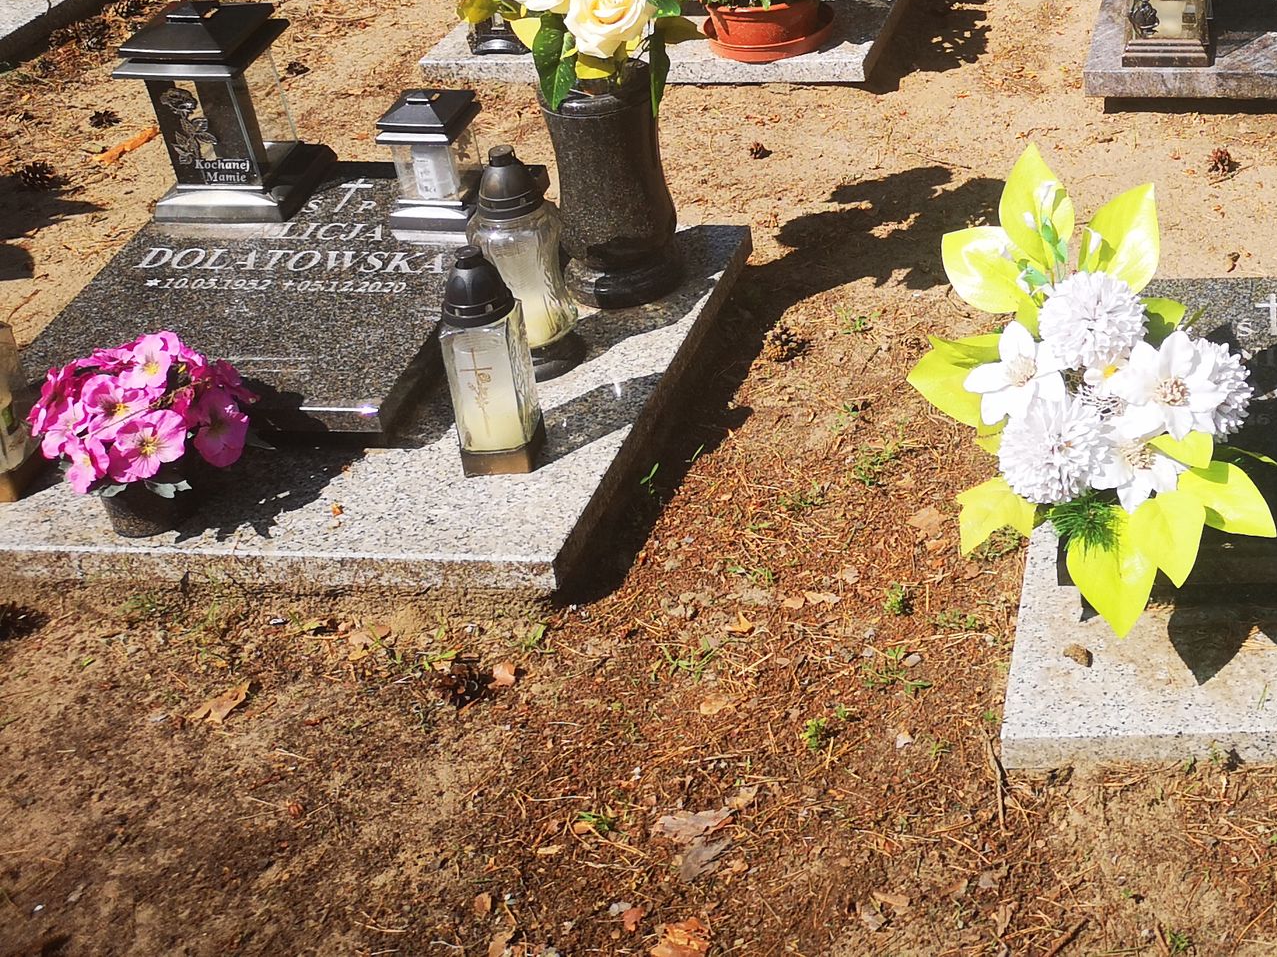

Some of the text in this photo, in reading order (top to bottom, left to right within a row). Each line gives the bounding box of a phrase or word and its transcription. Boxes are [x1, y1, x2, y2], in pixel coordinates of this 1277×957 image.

[195, 159, 250, 172] Kochanej
[206, 171, 247, 182] Mamie
[354, 200, 377, 213] P
[268, 222, 384, 241] LICJA
[133, 247, 445, 274] DOLATOWSKA
